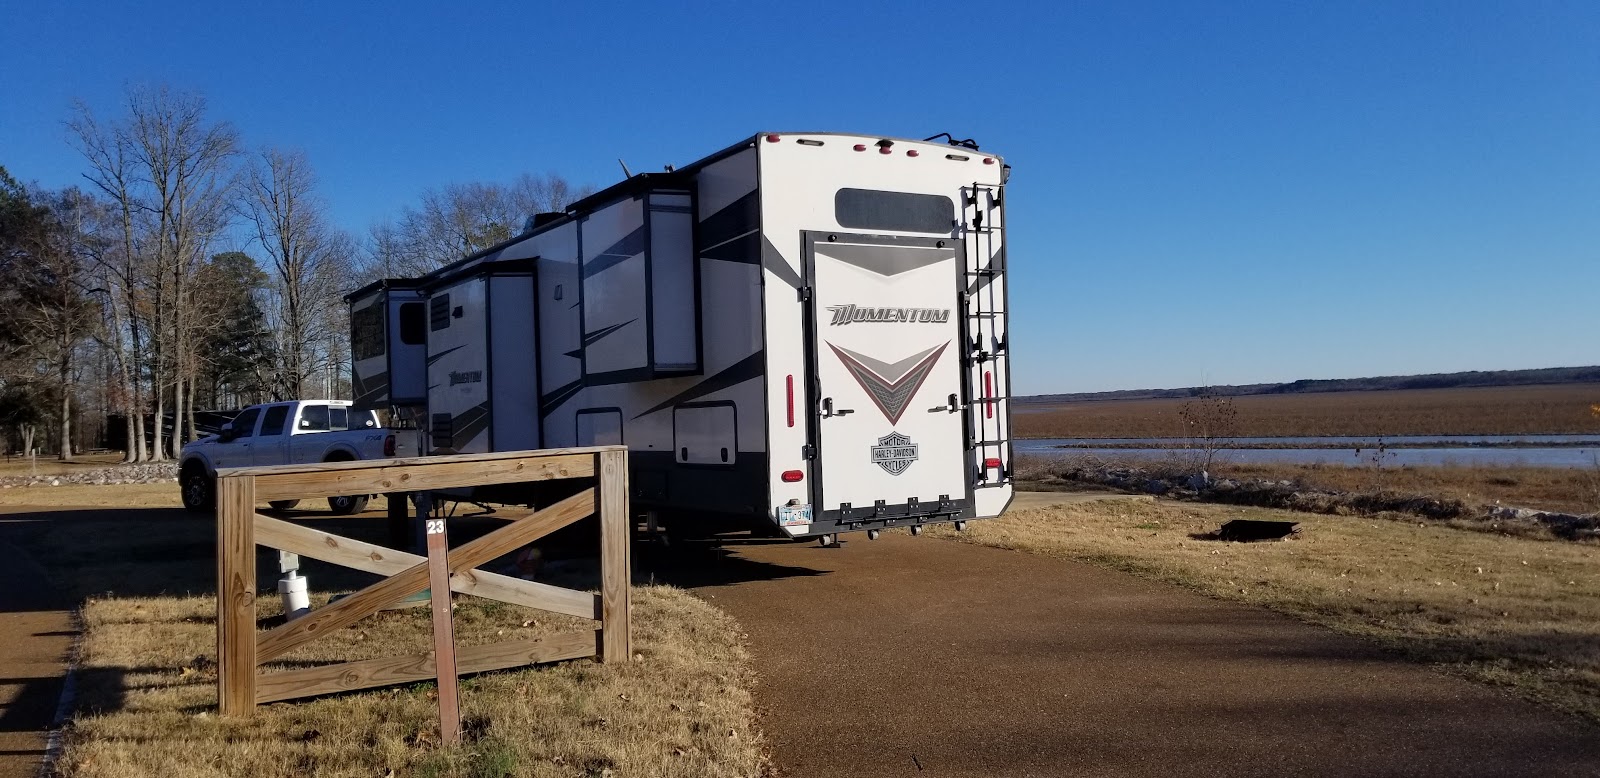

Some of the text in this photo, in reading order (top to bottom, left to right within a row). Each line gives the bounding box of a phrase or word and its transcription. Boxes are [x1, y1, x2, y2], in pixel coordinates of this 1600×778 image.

[825, 304, 950, 326] MOMENTUM
[884, 436, 906, 446] MOTOR
[874, 448, 916, 459] HARLEY-DAVIDSON
[884, 460, 906, 471] CYCLES
[427, 520, 445, 534] 23
